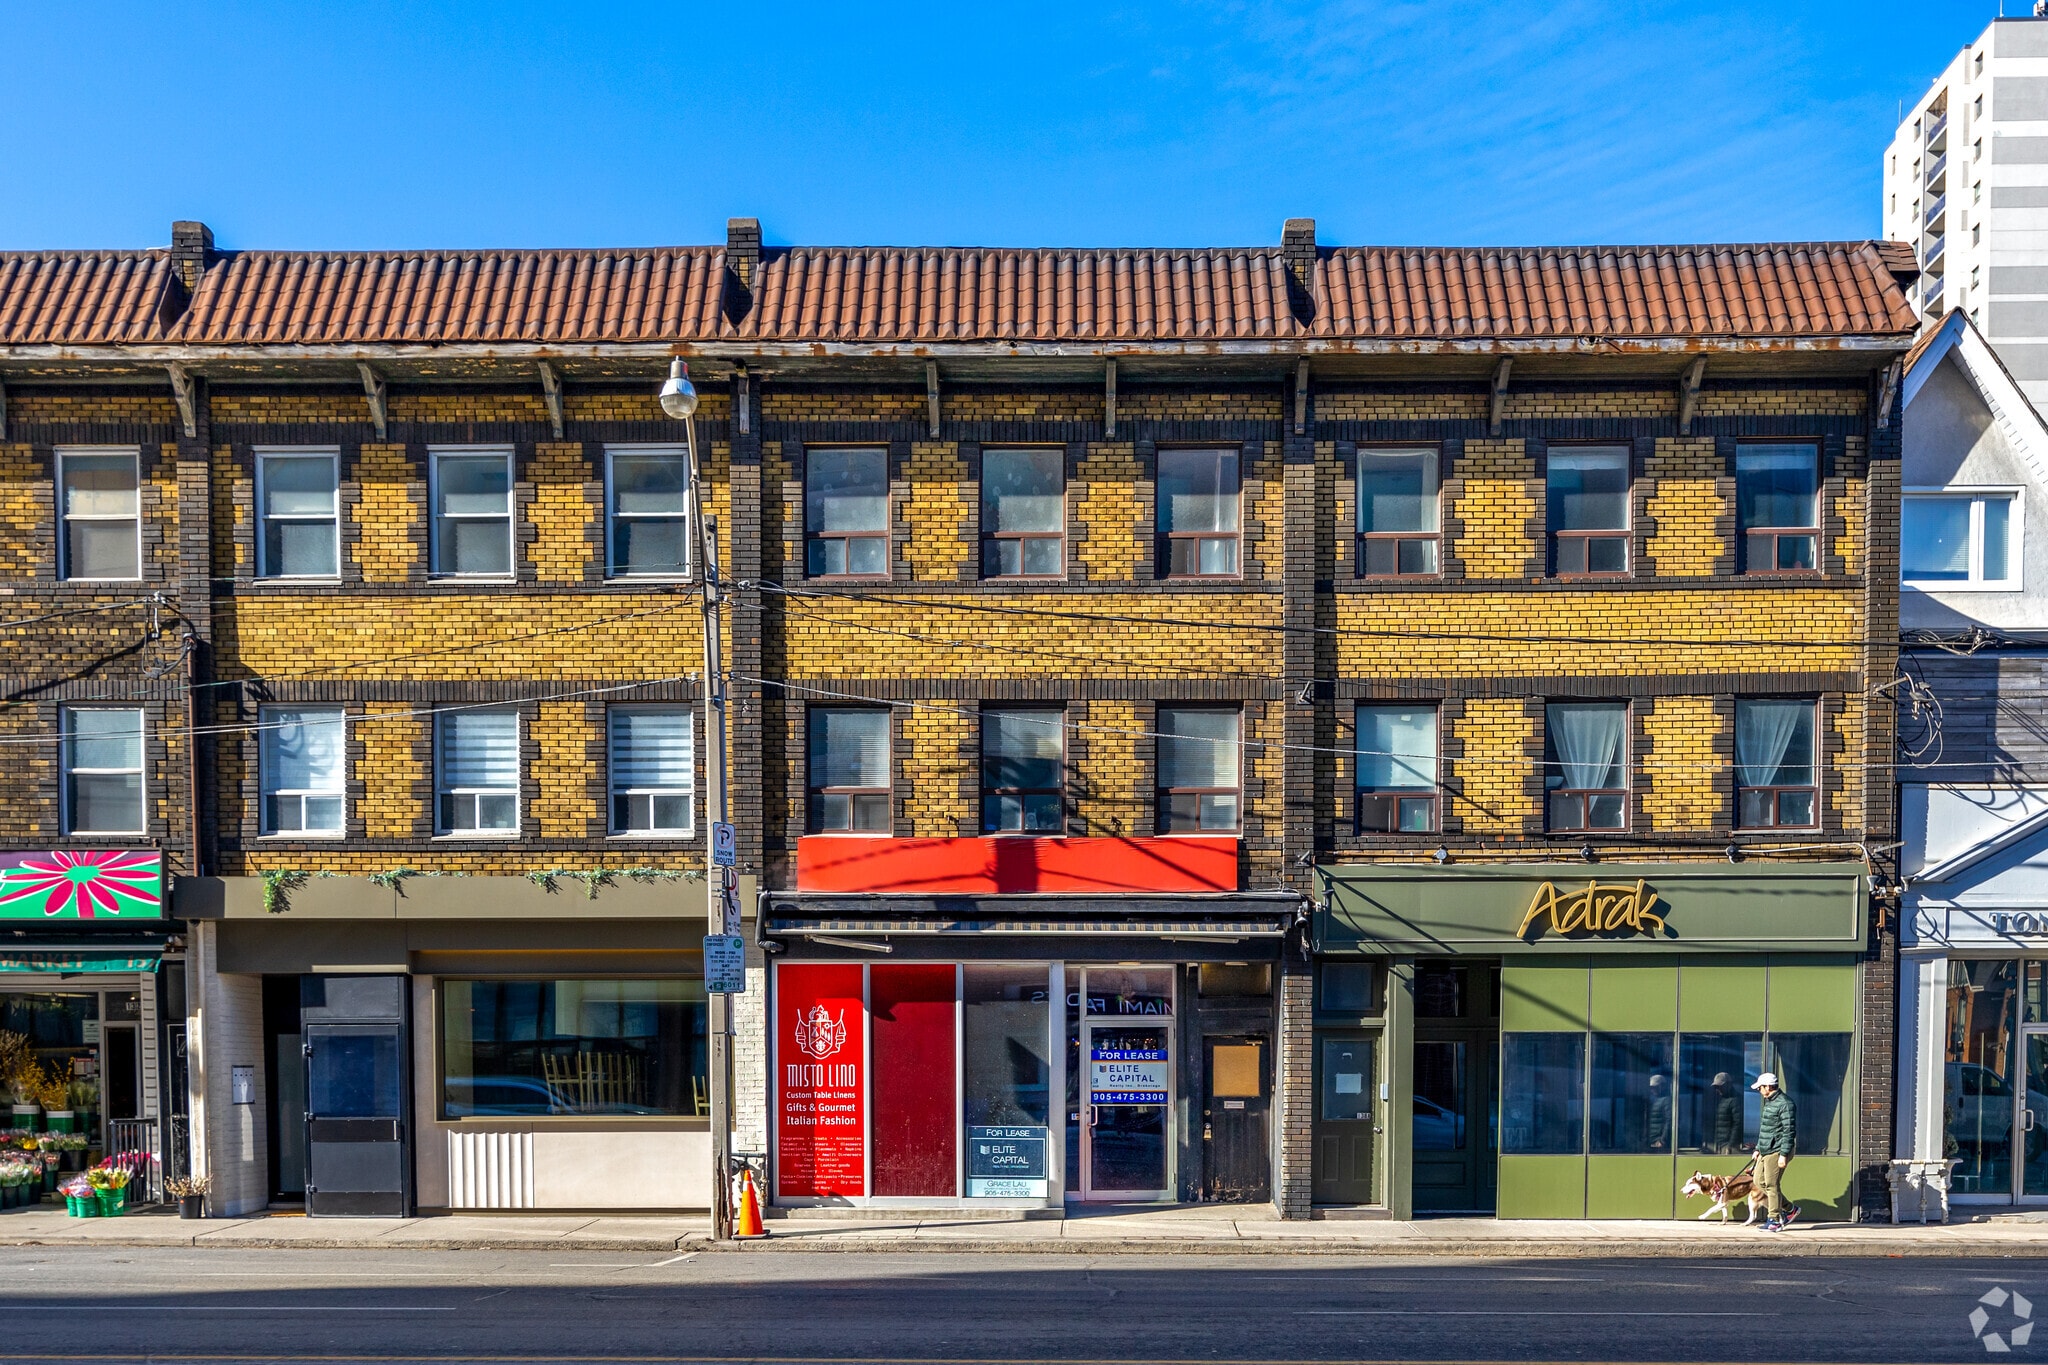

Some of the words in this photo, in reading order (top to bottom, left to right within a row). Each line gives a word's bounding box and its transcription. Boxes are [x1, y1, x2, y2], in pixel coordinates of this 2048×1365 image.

[716, 857, 733, 865] ROUTE
[1516, 879, 1664, 938] Adrak
[0, 953, 86, 968] MARKET
[1100, 1052, 1120, 1060] FOR
[1124, 1052, 1158, 1060] LEASE
[1109, 1065, 1139, 1073] ELITE
[786, 1064, 824, 1088] MISTO
[828, 1064, 856, 1088] LINO
[1109, 1074, 1155, 1082] CAPITAL
[786, 1091, 812, 1099] Custom
[813, 1091, 832, 1099] Table
[833, 1091, 856, 1099] Linens
[1093, 1093, 1164, 1101] 905-475-3300
[786, 1103, 807, 1112] Gifts
[809, 1103, 816, 1112] &
[818, 1103, 856, 1112] Gourmet
[787, 1115, 817, 1125] Italian
[820, 1115, 856, 1125] Fashion
[986, 1129, 1003, 1137] FOR
[1005, 1129, 1030, 1137] LEASE
[992, 1145, 1016, 1154] ELITE
[991, 1156, 1029, 1164] CAPITAL
